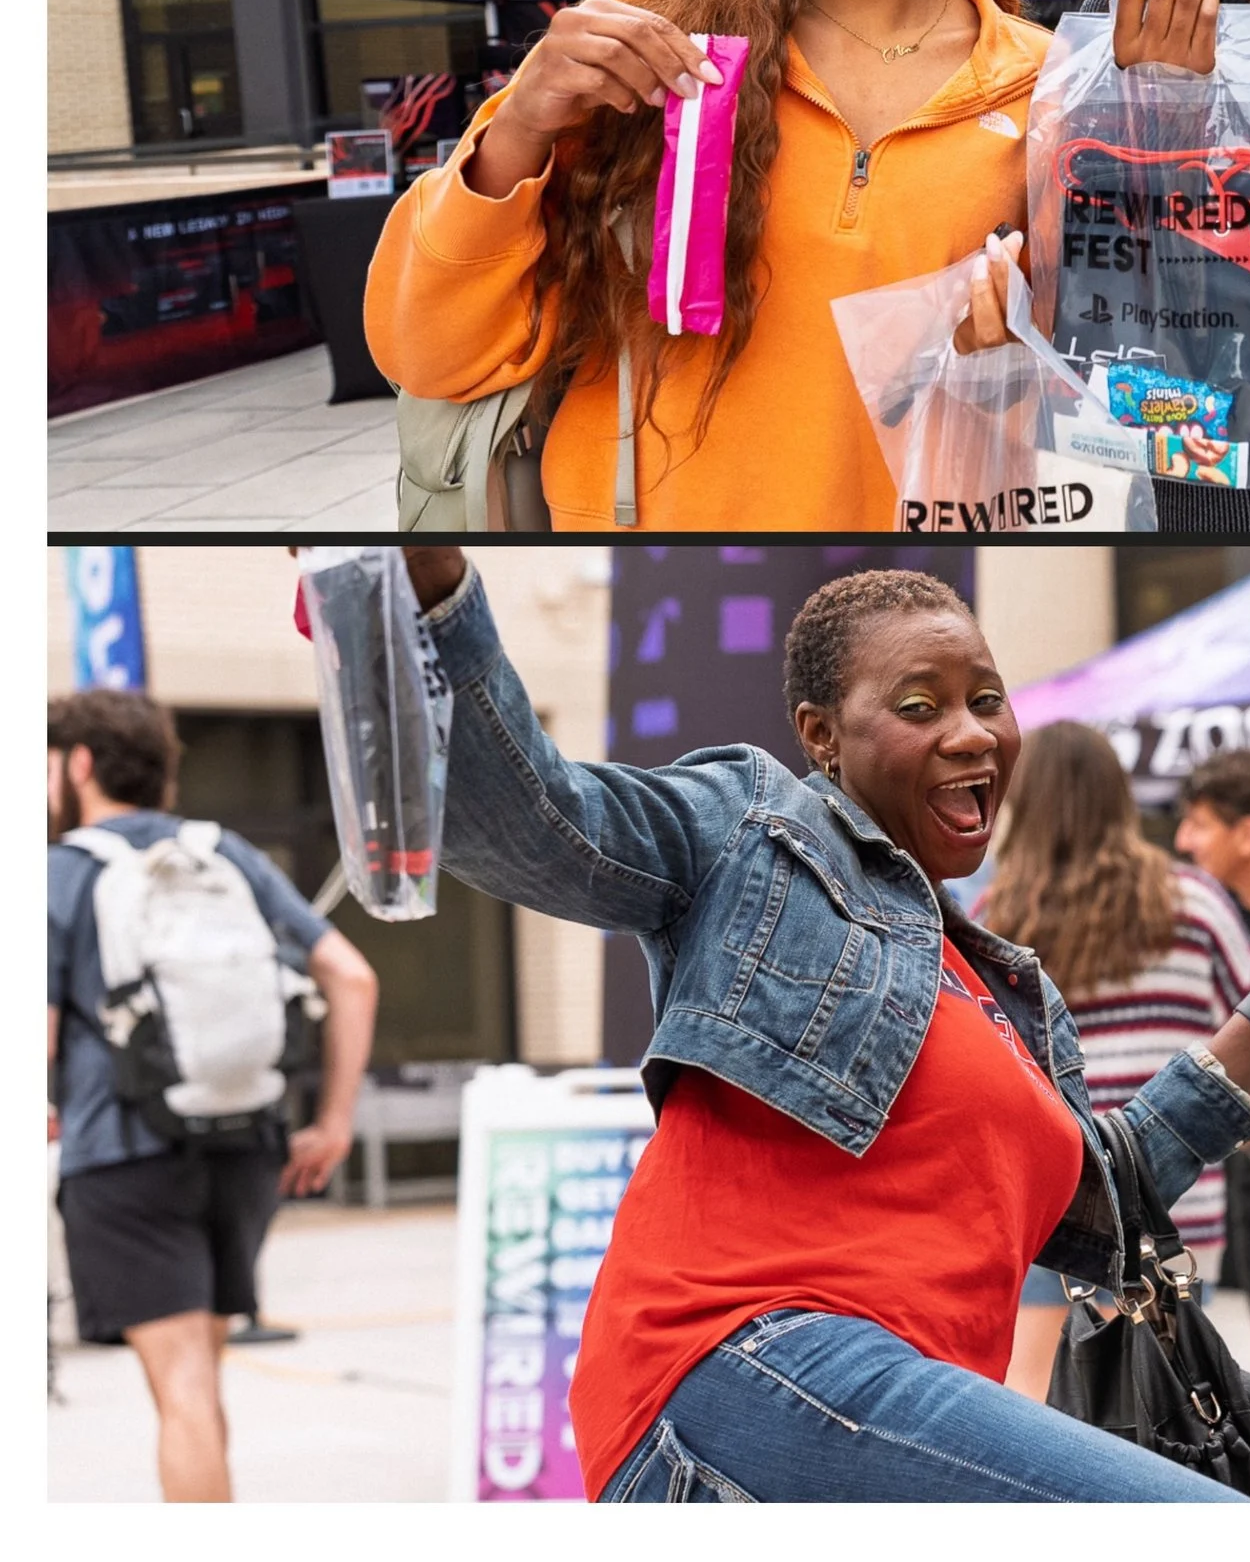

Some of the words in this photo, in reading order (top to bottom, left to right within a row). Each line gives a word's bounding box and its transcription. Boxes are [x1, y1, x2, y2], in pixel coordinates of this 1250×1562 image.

[143, 222, 175, 239] NEW
[1061, 233, 1152, 275] FEST
[903, 483, 1093, 532] REWIRED
[482, 1141, 549, 1491] REWIRED
